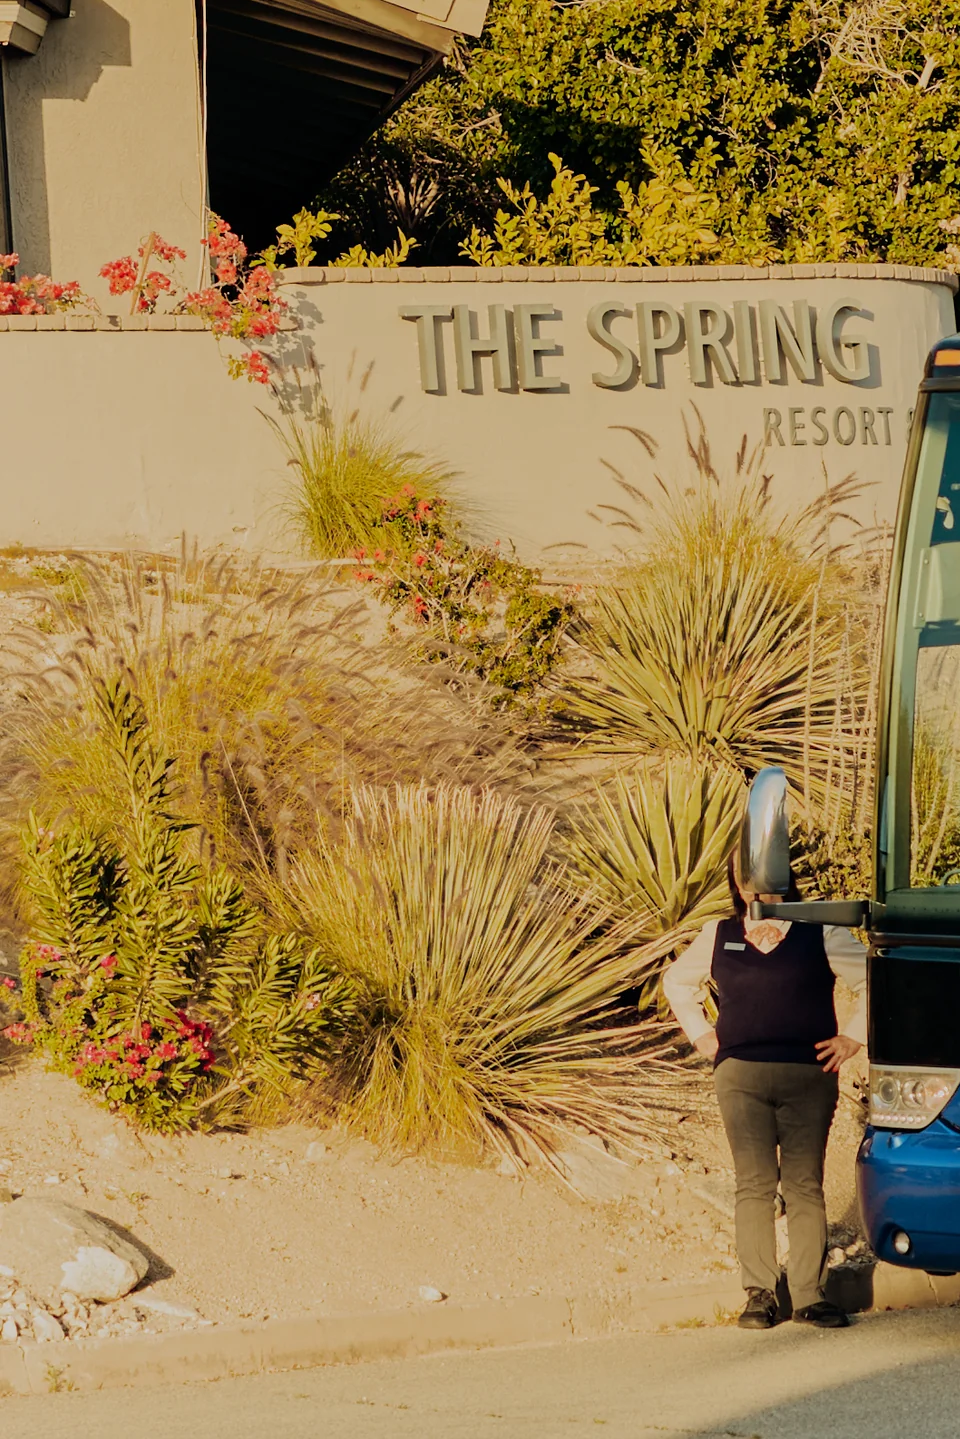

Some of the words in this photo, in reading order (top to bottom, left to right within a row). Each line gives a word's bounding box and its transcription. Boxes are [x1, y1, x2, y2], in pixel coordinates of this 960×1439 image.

[399, 302, 563, 392] THE
[586, 297, 876, 388] SPRING
[763, 406, 894, 447] RESORT
